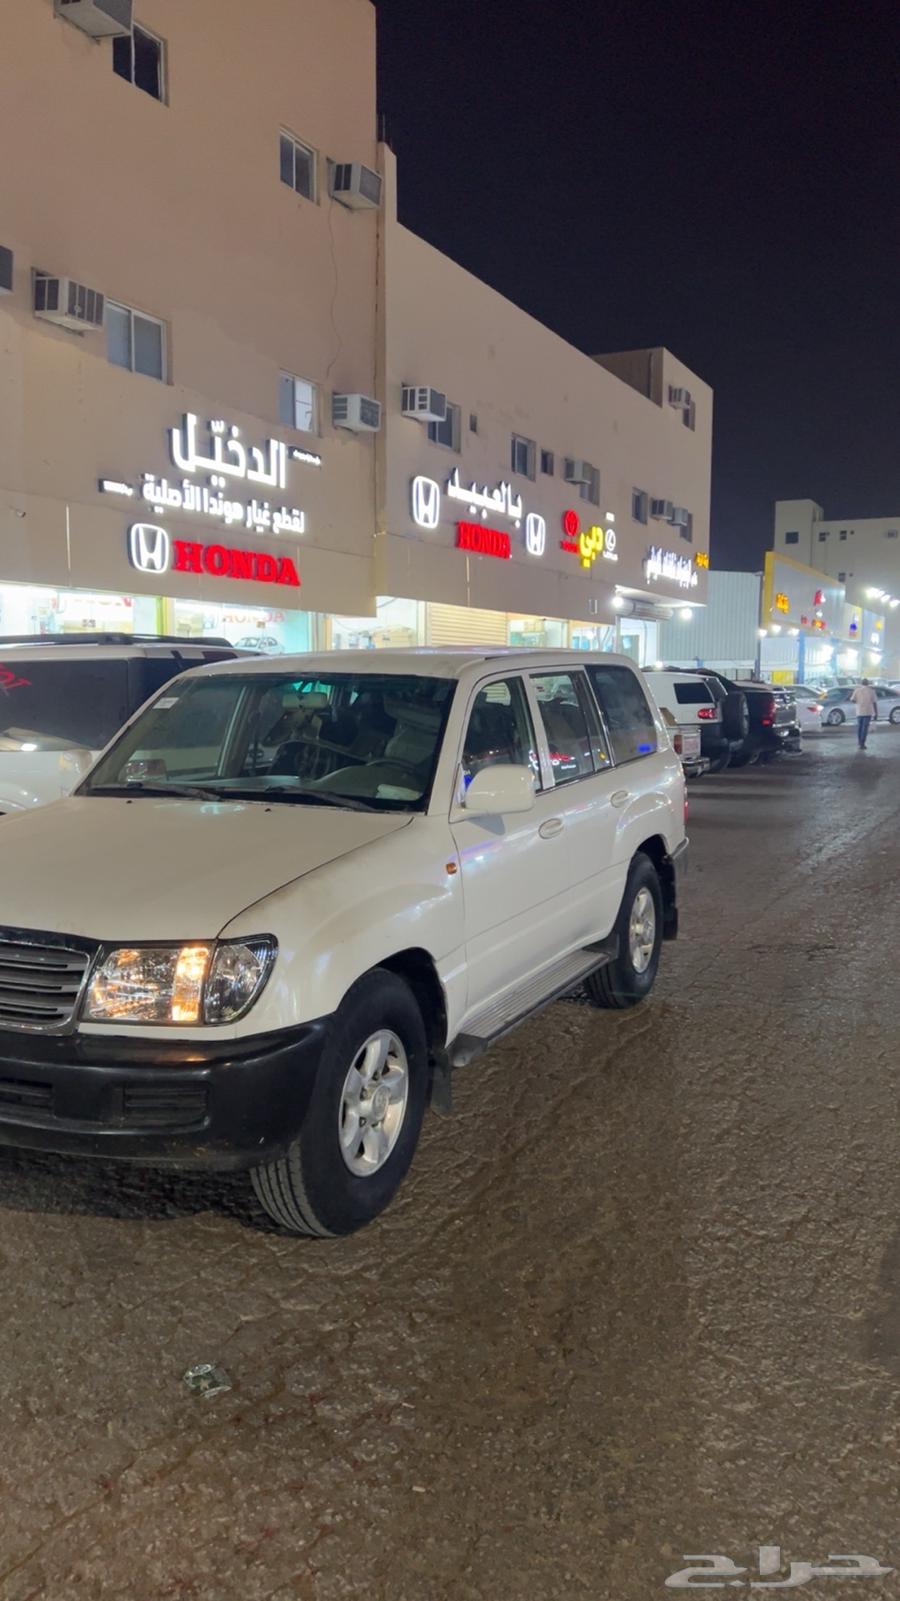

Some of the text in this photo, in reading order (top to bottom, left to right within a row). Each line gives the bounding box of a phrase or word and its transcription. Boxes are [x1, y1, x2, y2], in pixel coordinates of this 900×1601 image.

[143, 474, 202, 514] الأصلية
[203, 488, 244, 523] هوندا
[246, 500, 271, 533] غيار
[272, 507, 305, 534] لقطع
[458, 520, 511, 560] HONDA
[172, 539, 301, 586] HONDA
